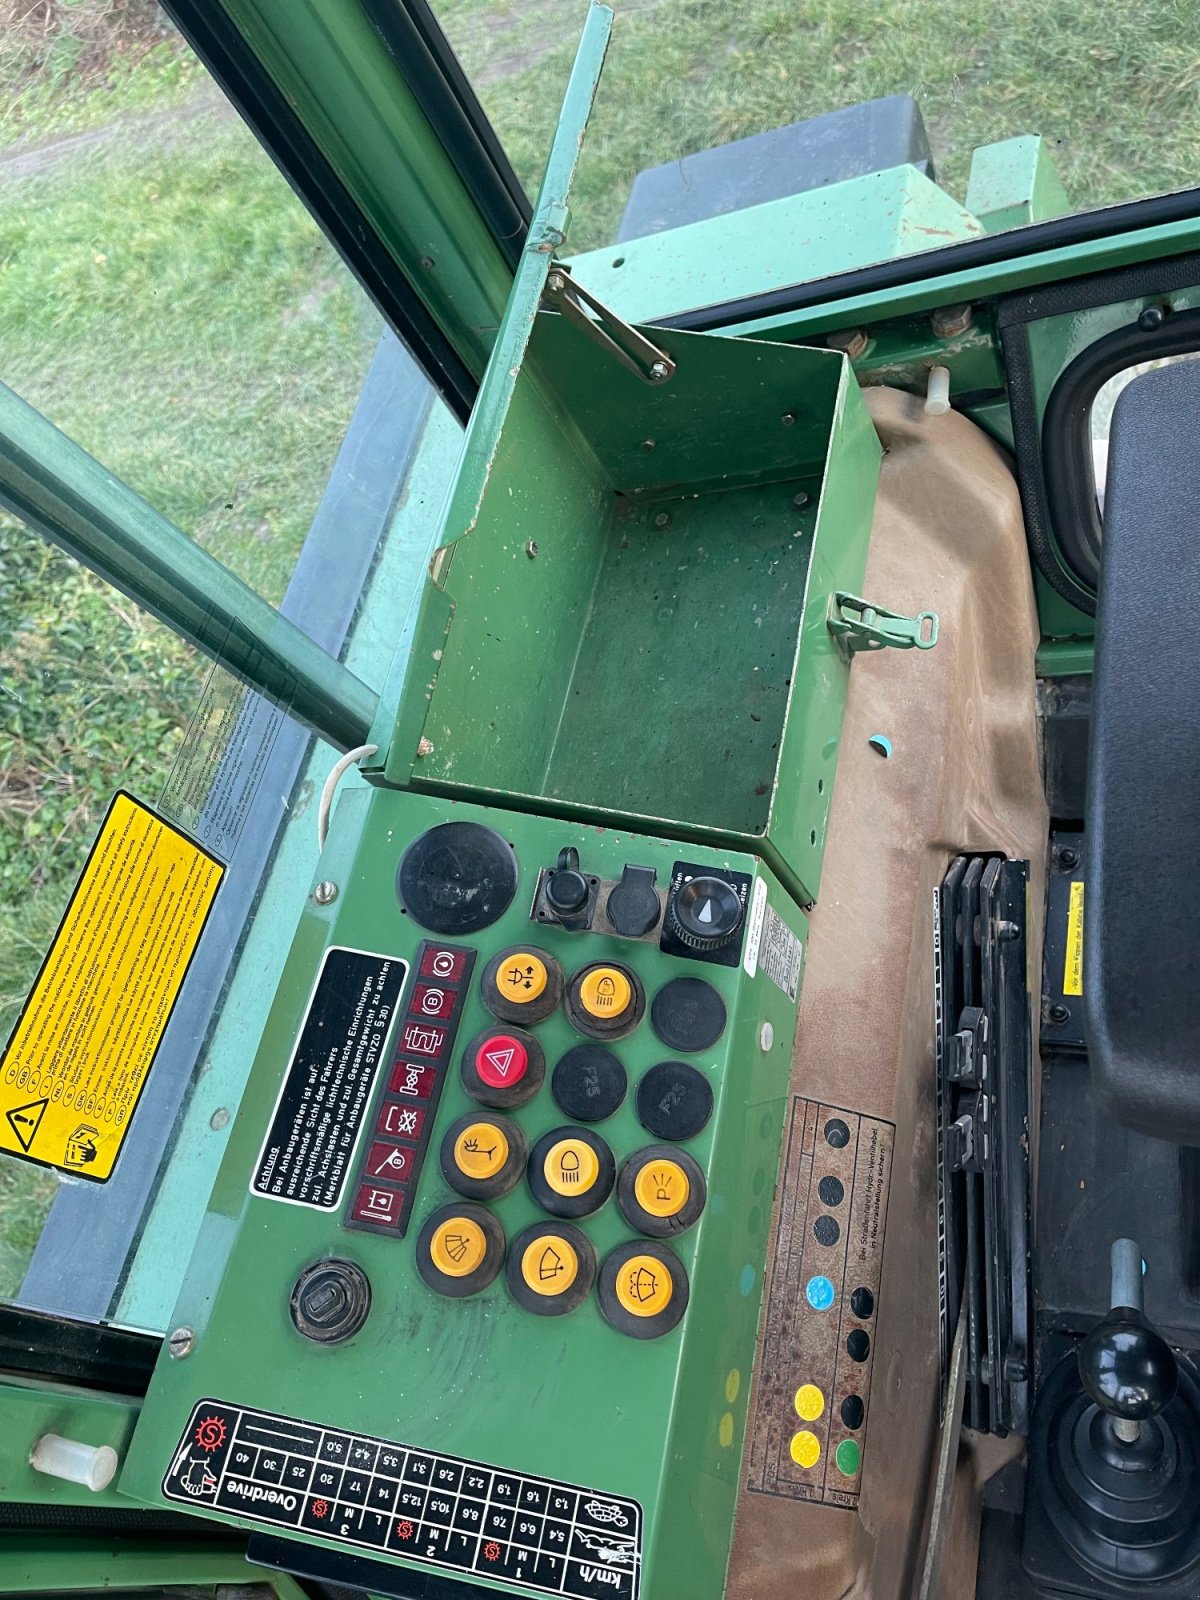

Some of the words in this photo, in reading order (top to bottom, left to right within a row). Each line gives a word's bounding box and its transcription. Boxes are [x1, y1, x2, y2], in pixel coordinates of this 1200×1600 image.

[374, 960, 392, 990] achten
[371, 993, 382, 1005] zu
[25, 1049, 35, 1065] Prior
[32, 1041, 39, 1049] to
[36, 1012, 51, 1042] operating
[47, 1002, 55, 1013] the
[52, 976, 66, 1003] machine
[63, 963, 72, 977] read
[69, 951, 77, 963] and
[36, 1052, 46, 1070] Avant
[46, 1030, 55, 1045] mise
[347, 1008, 378, 1081] Gesamtgewicht
[9, 1068, 16, 1076] D
[14, 1050, 22, 1061] Vor
[296, 1111, 333, 1199] vorschriftsmäßige
[325, 1038, 354, 1108] lichttechnische
[347, 975, 375, 1037] Einrichtungen
[301, 1086, 312, 1099] ist
[341, 1082, 354, 1100] zul.
[345, 1067, 374, 1129] Anbaugeräte
[334, 1102, 348, 1121] und
[284, 1131, 312, 1195] ausreichende
[306, 1102, 321, 1128] Sicht
[314, 1085, 326, 1101] des
[320, 1046, 339, 1082] Fahrers
[277, 1102, 309, 1173] Anbaugeräten
[339, 1131, 352, 1146] für
[317, 1124, 341, 1178] Achslasten
[271, 1176, 284, 1193] Bei
[321, 1151, 347, 1206] (Merkblatt
[310, 1182, 323, 1202] zul.
[870, 1177, 884, 1239] Neutralstellung
[859, 1193, 872, 1245] Straßenfahrt
[234, 1451, 250, 1464] 40
[354, 1446, 371, 1460] 4,2
[381, 1453, 399, 1467] 3,5
[261, 1457, 277, 1470] 30
[411, 1460, 427, 1474] 3,1
[290, 1465, 306, 1478] 25
[318, 1472, 334, 1484] 20
[438, 1467, 454, 1481] 2,6
[349, 1479, 362, 1491] 17
[467, 1474, 485, 1489] 2,2
[496, 1481, 512, 1496] 1,9
[223, 1479, 298, 1511] Overdrive
[377, 1486, 390, 1498] 14
[400, 1491, 422, 1507] 12,5
[525, 1488, 541, 1503] 1,6
[429, 1498, 451, 1514] 10,5
[554, 1495, 569, 1510] 1,3
[343, 1506, 354, 1518] M
[374, 1514, 381, 1524] L
[461, 1506, 479, 1520] 8,6
[491, 1514, 507, 1527] 7,6
[519, 1520, 536, 1534] 6,6
[338, 1523, 350, 1535] 3
[428, 1527, 439, 1539] M
[548, 1527, 565, 1542] 5,4
[459, 1535, 467, 1546] L
[425, 1544, 435, 1557] 2
[517, 1549, 527, 1561] M
[547, 1556, 555, 1568] L
[515, 1566, 521, 1577] 1
[578, 1563, 621, 1589] km/h
